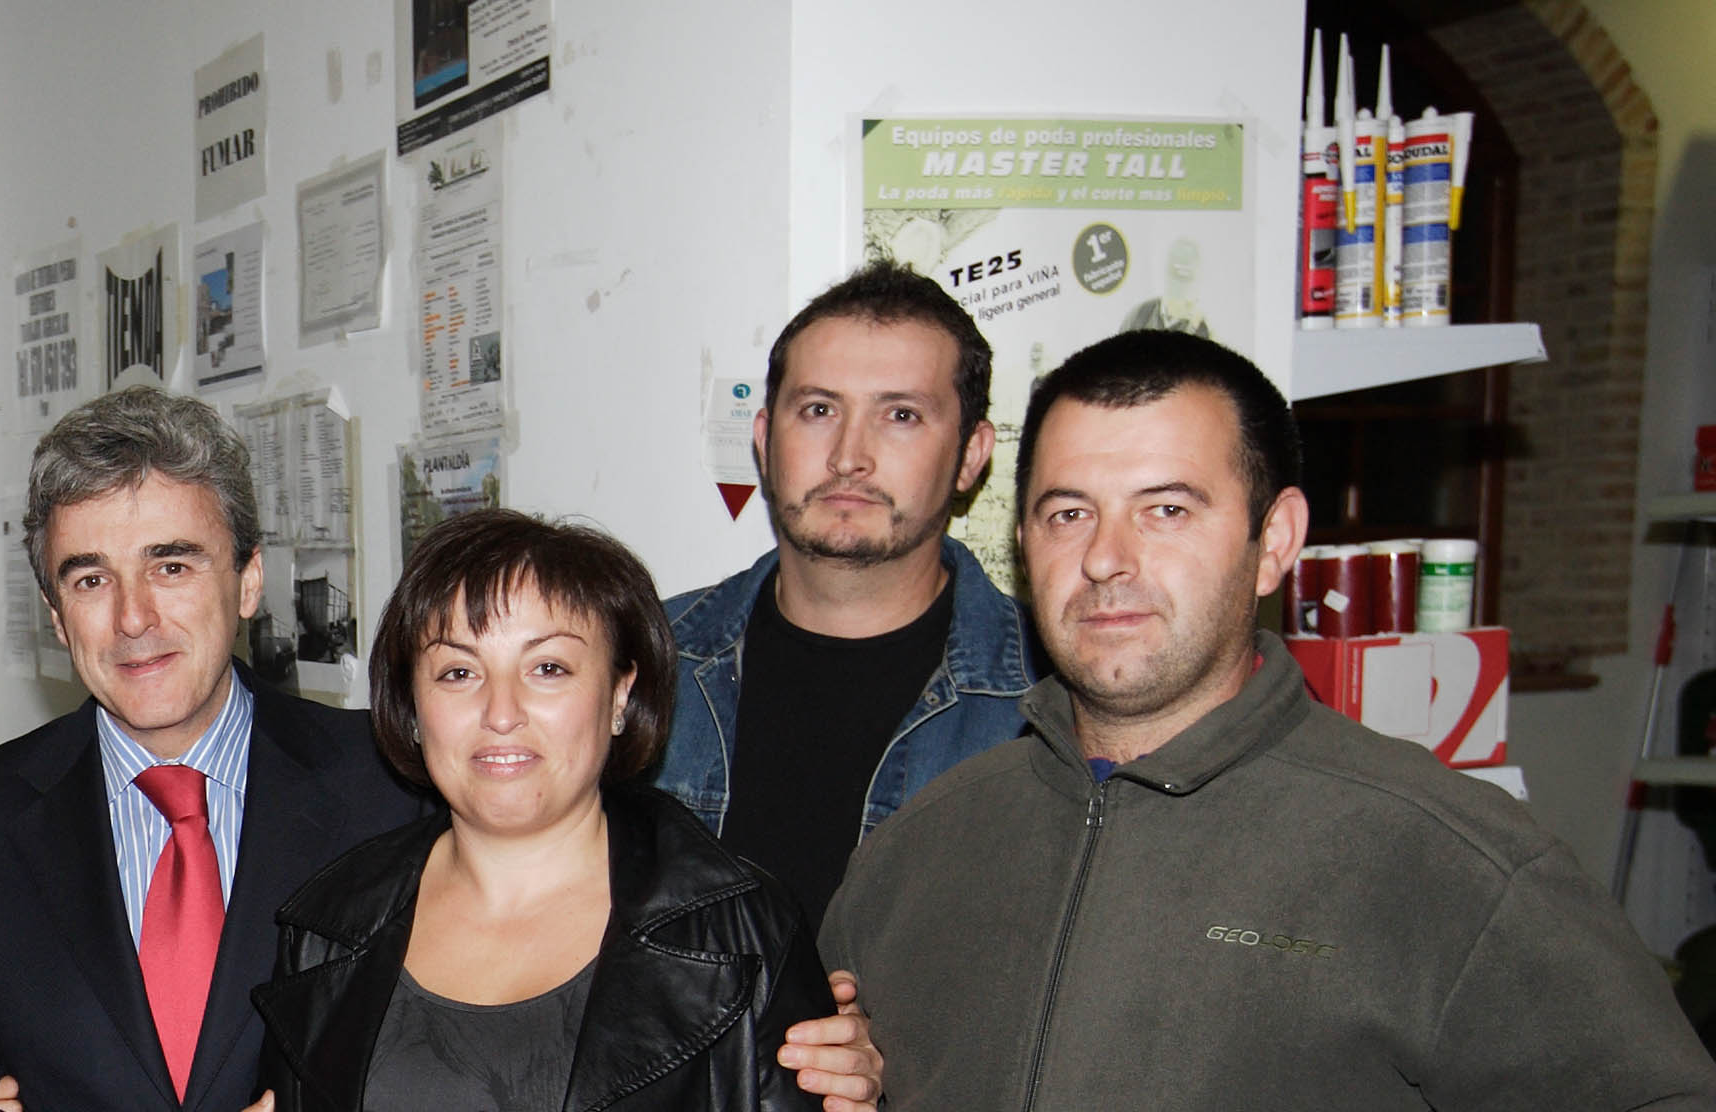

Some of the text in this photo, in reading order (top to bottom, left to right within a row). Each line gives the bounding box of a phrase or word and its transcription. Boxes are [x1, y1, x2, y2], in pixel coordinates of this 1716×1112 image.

[198, 71, 260, 120] PROHIBIDO
[202, 128, 255, 176] FUMAR
[892, 125, 1217, 149] Equipos de poda profesionales
[922, 150, 1187, 179] MASTER TALL
[878, 184, 901, 200] La
[905, 185, 949, 202] poda
[1057, 188, 1068, 202] y
[949, 250, 1023, 287] TE25
[960, 264, 1060, 308] cial para VIÑA
[978, 283, 1062, 321] ligera general
